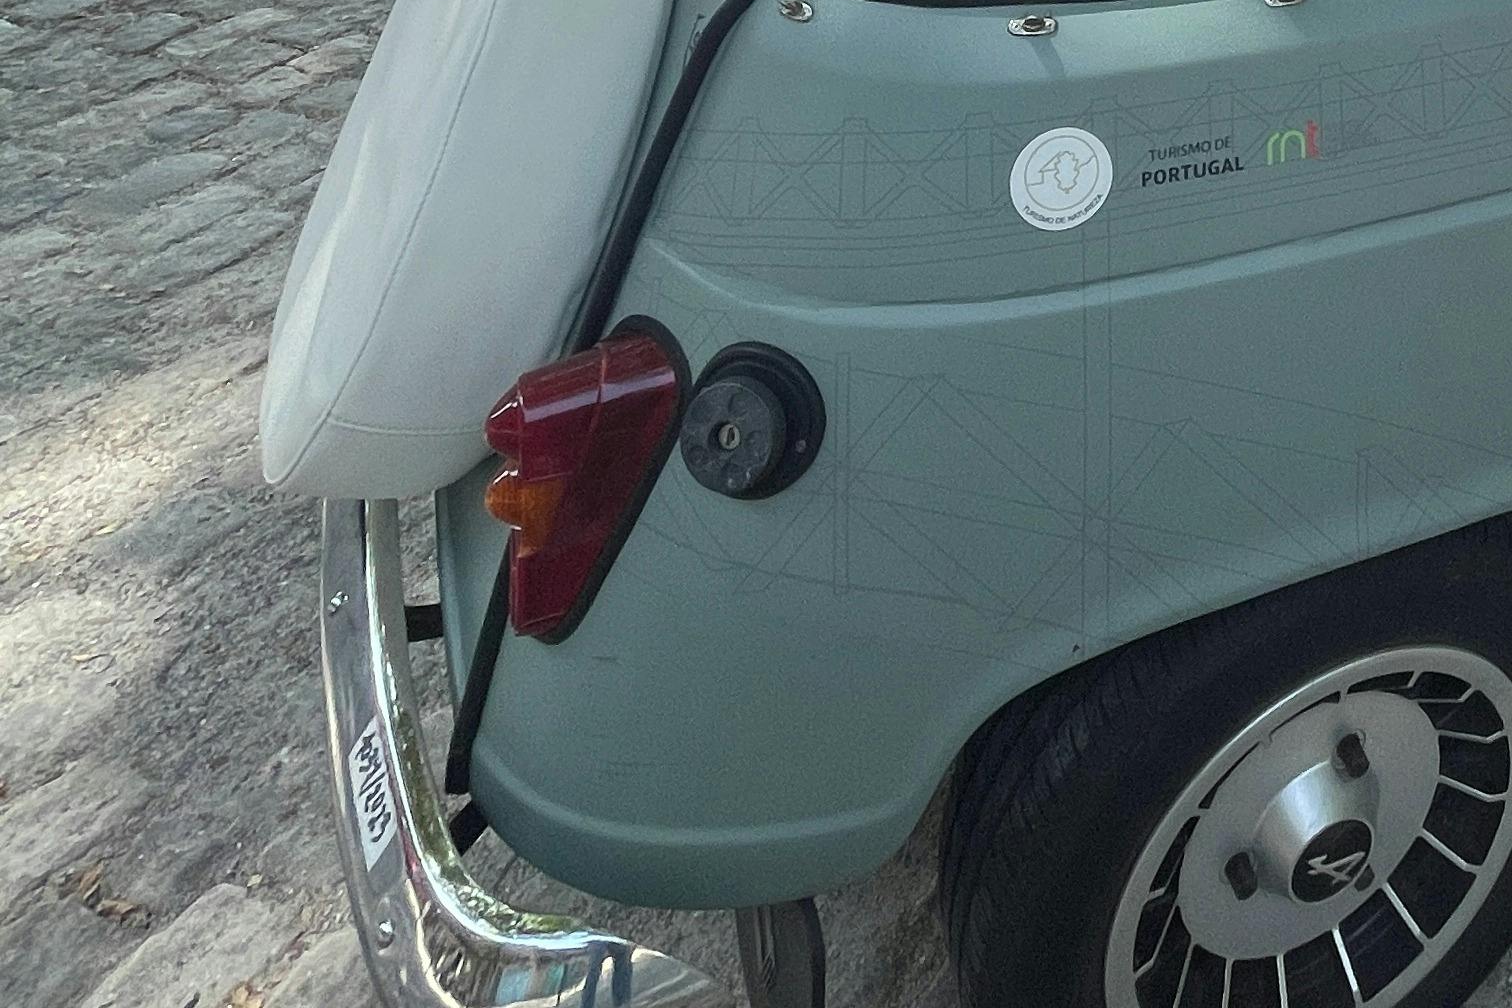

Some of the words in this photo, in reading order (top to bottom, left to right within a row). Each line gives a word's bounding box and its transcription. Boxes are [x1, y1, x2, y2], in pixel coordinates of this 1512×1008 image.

[1149, 140, 1212, 162] TURISMO
[1214, 135, 1232, 151] DE
[1141, 156, 1245, 187] PORTUGAL
